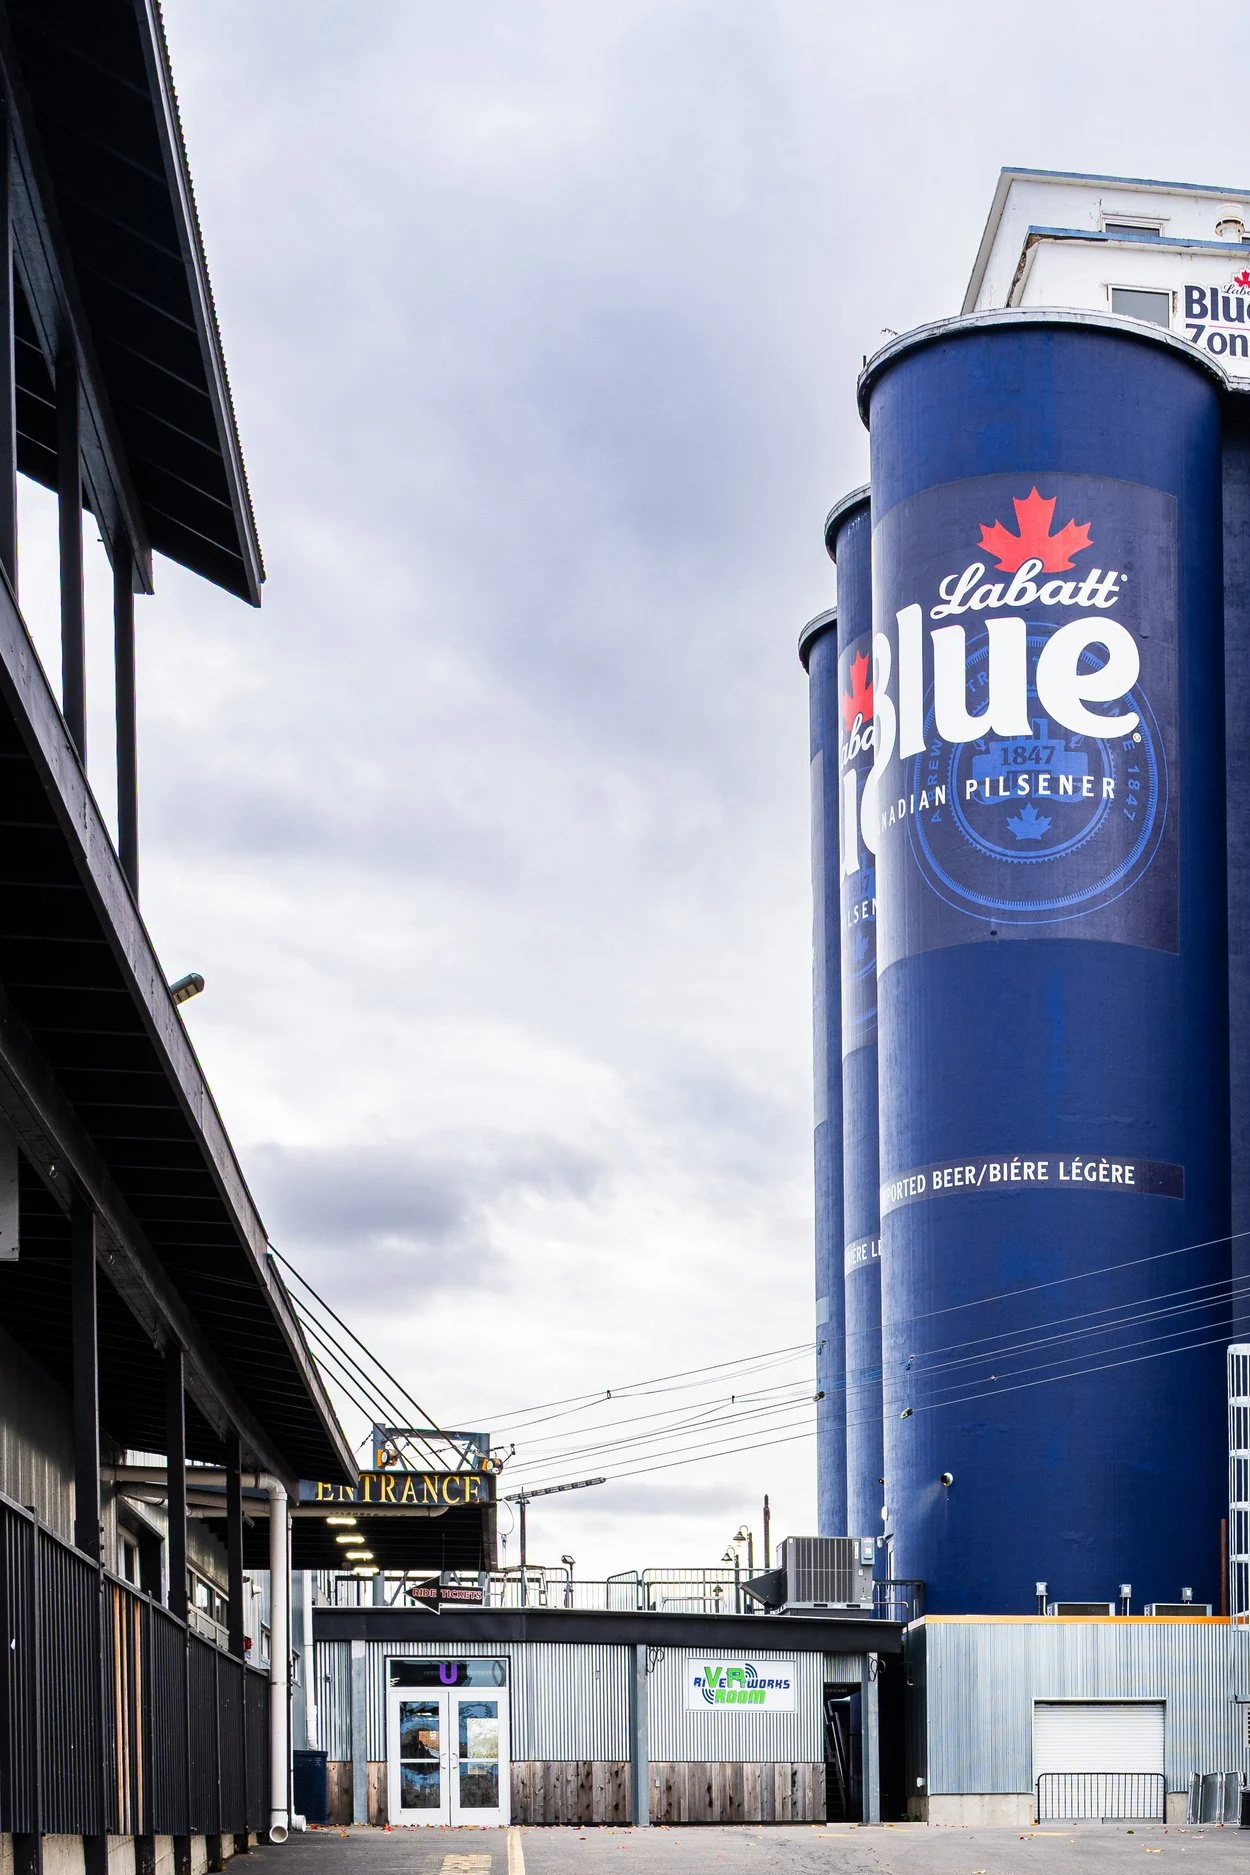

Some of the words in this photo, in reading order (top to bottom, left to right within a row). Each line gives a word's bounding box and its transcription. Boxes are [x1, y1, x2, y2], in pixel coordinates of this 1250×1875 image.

[930, 558, 1120, 619] Labatt
[1000, 746, 1056, 767] 1847
[966, 774, 1115, 799] PILSENER
[316, 1473, 481, 1504] ENTRANCE
[412, 1588, 437, 1598] RIDE
[441, 1588, 483, 1600] TICKETS
[714, 1689, 766, 1704] ROOM
